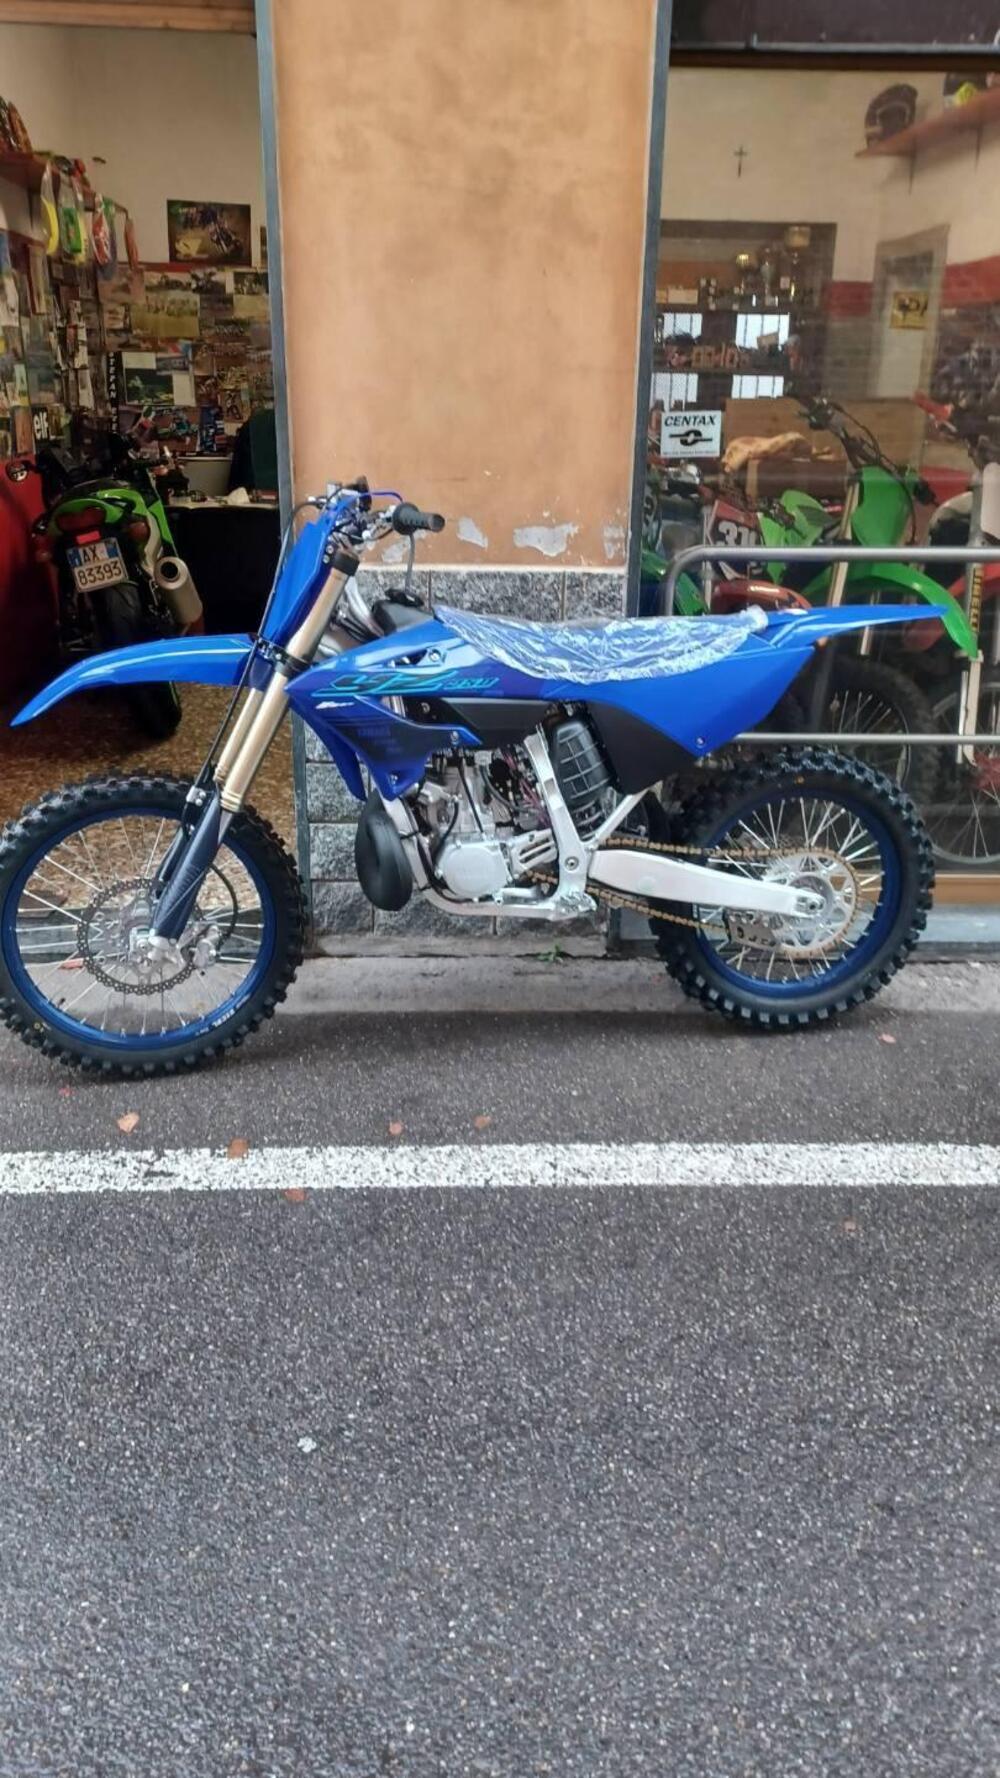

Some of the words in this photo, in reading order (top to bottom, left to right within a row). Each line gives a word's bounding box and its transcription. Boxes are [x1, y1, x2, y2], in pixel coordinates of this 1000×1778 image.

[33, 411, 49, 440] elf
[664, 415, 716, 427] CENTAX
[82, 544, 99, 562] AX
[77, 560, 122, 586] 83393
